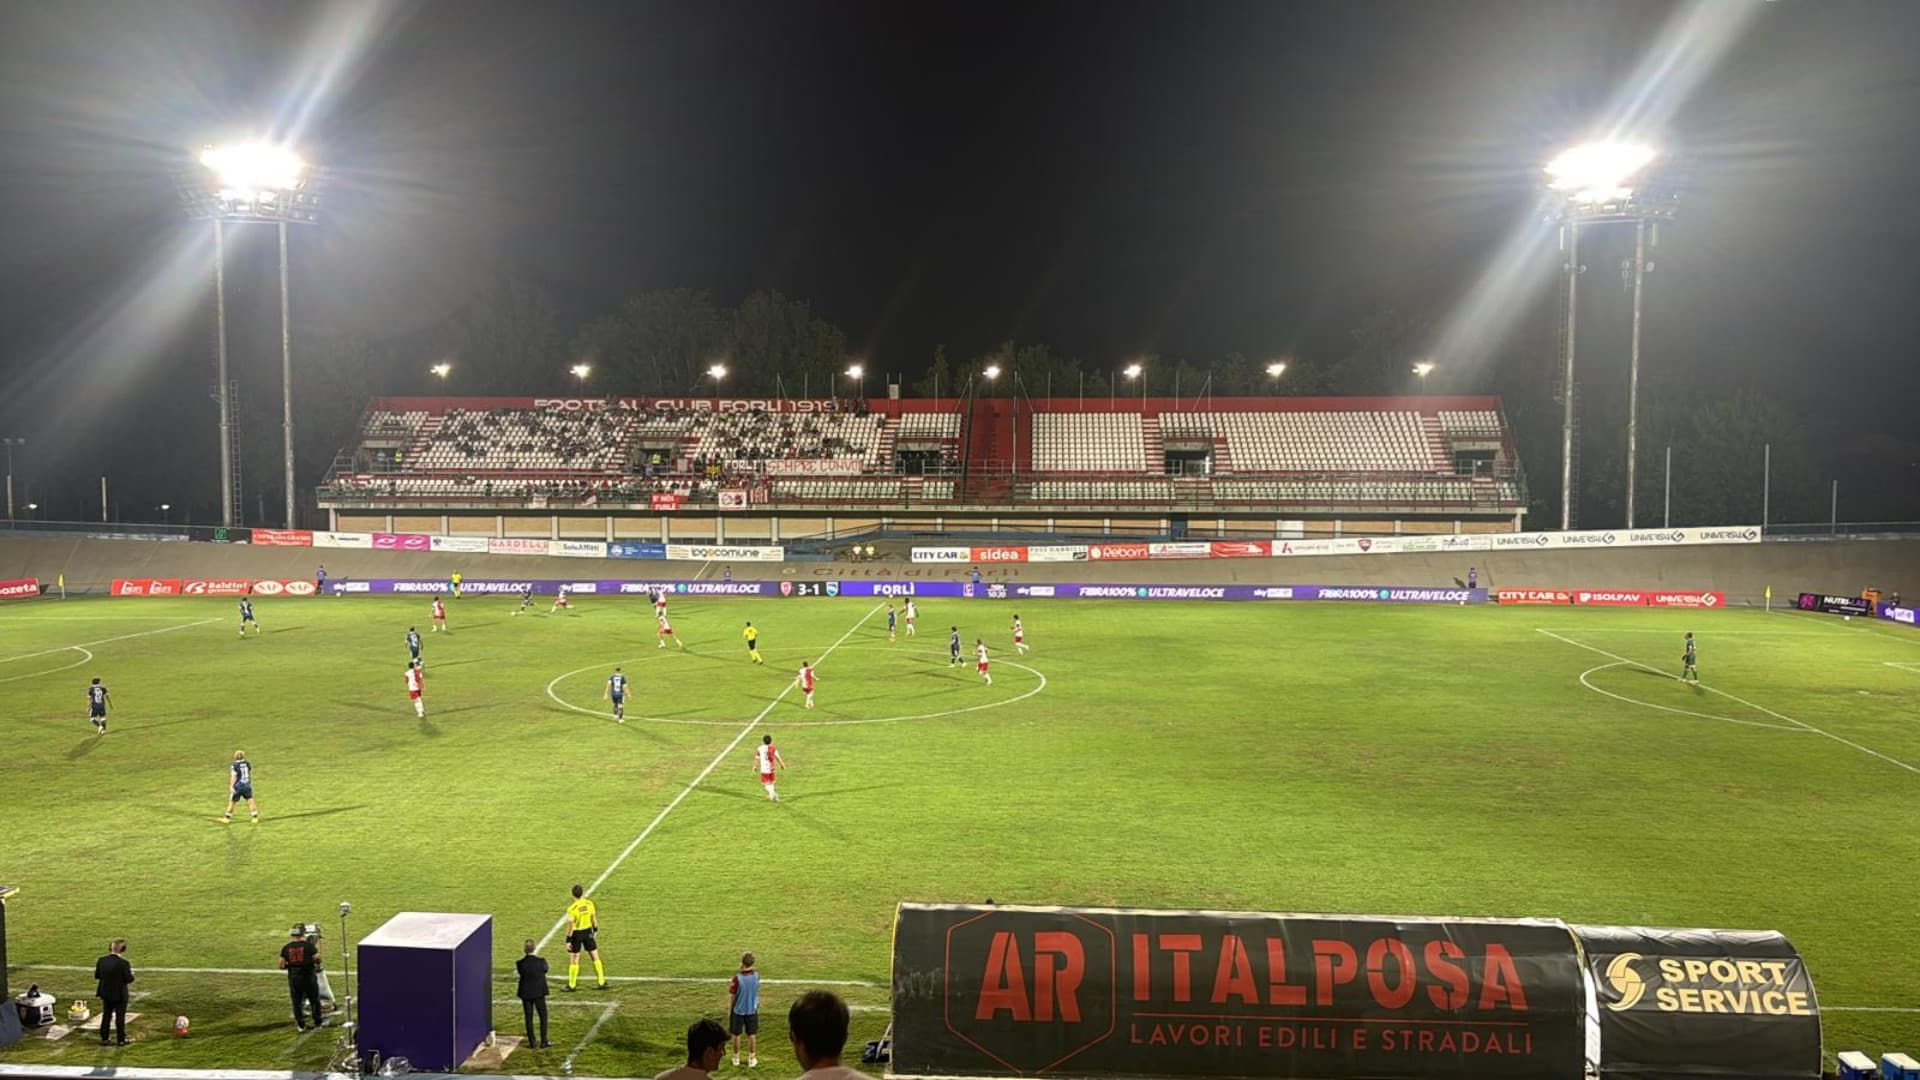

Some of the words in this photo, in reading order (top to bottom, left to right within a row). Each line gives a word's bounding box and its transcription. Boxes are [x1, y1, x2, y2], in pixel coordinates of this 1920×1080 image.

[913, 551, 935, 560] CITY
[937, 551, 958, 560] CAR
[979, 547, 1019, 561] sidea
[1102, 547, 1148, 558] Reborn
[0, 583, 37, 595] ozeta
[393, 582, 448, 592] FIBRA100%
[687, 583, 761, 594] ULTRAVELOCE
[797, 583, 820, 596] 3-1
[873, 581, 915, 595] FORLÌ
[1079, 586, 1137, 597] FIBRA100%
[1148, 587, 1225, 598] ULTRAVELOCE
[1318, 589, 1379, 599] FIBRA100%
[1390, 589, 1470, 601] ULTRAVELOCE
[1498, 591, 1527, 600] CITY
[1529, 591, 1555, 600] CAR
[1592, 593, 1641, 601] ISOLPAV
[975, 931, 1086, 1023] AR
[1132, 934, 1529, 1011] ITALPOSA
[1658, 958, 1786, 986] SPORT
[1655, 987, 1811, 1016] SERVICE
[1130, 1023, 1243, 1047] LAVORI
[1258, 1025, 1337, 1049] EDILI
[1352, 1028, 1368, 1050] E
[1381, 1028, 1532, 1055] STRADALI
